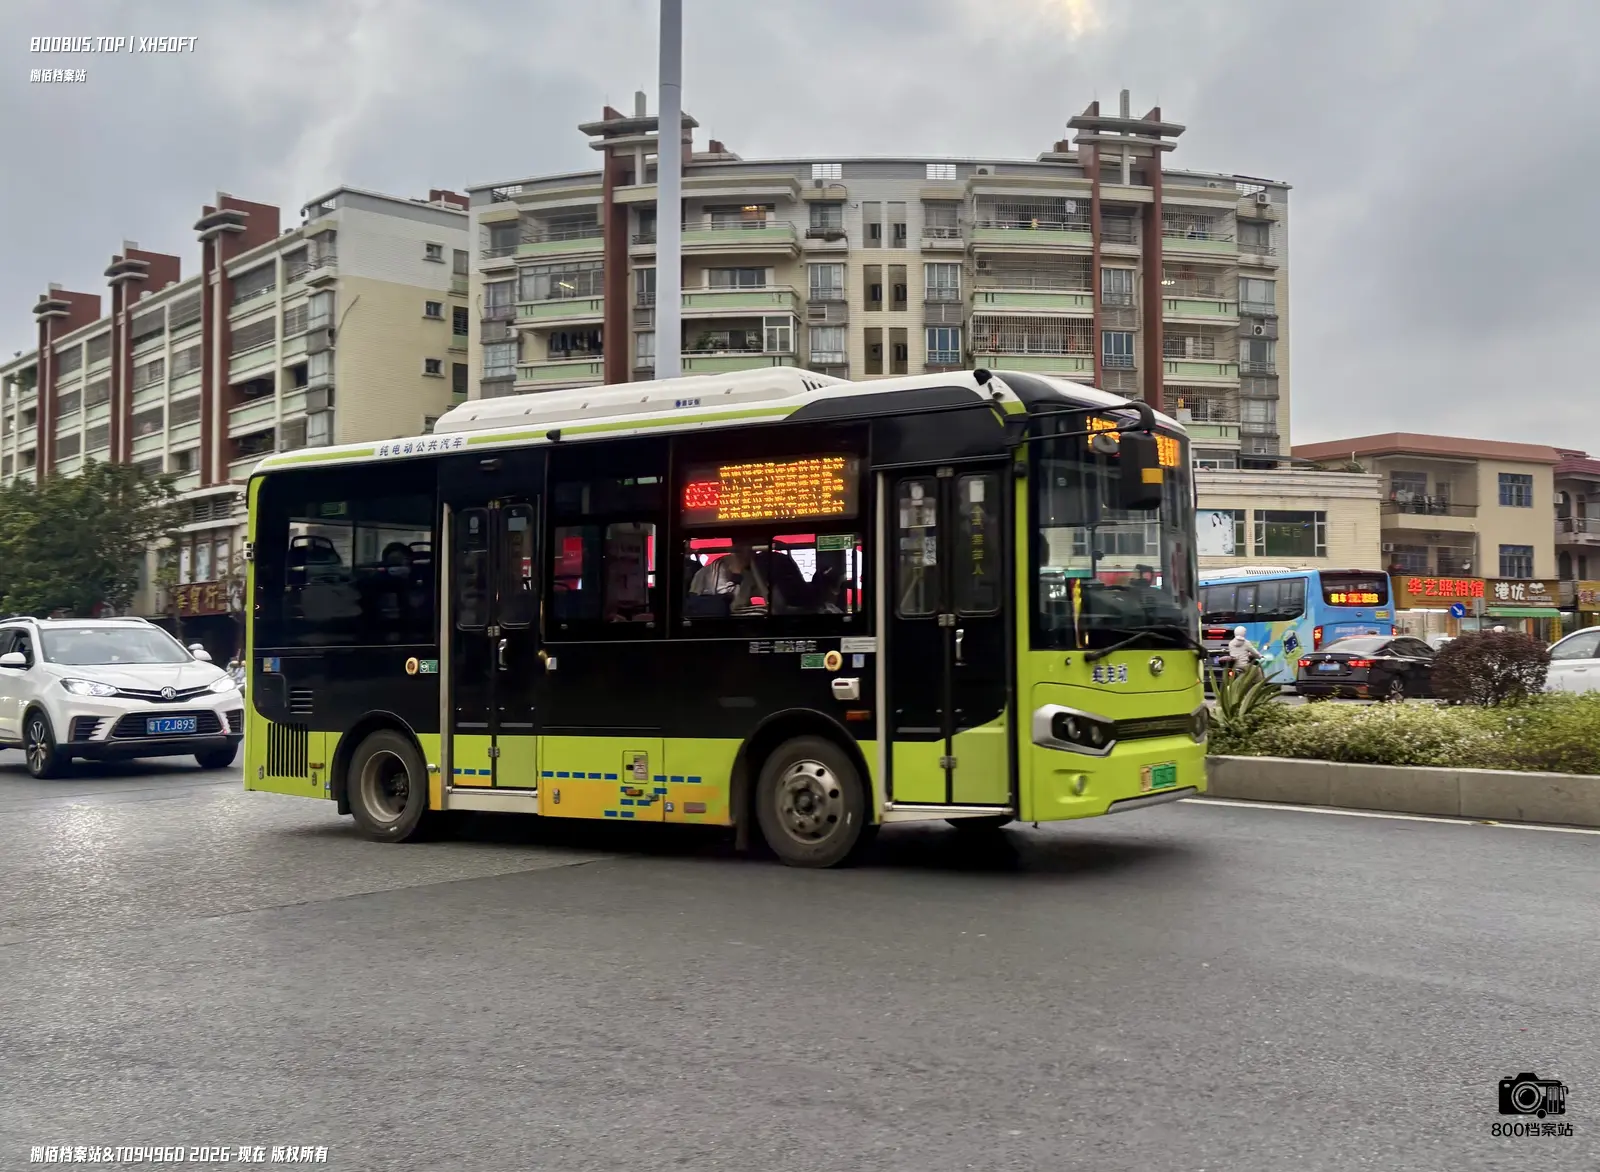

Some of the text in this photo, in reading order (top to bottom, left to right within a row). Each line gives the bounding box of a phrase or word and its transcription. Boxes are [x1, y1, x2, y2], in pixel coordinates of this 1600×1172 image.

[379, 437, 464, 457] 纯电动公共汽车
[1407, 578, 1485, 598] 华艺照相馆
[1494, 582, 1526, 601] 港优
